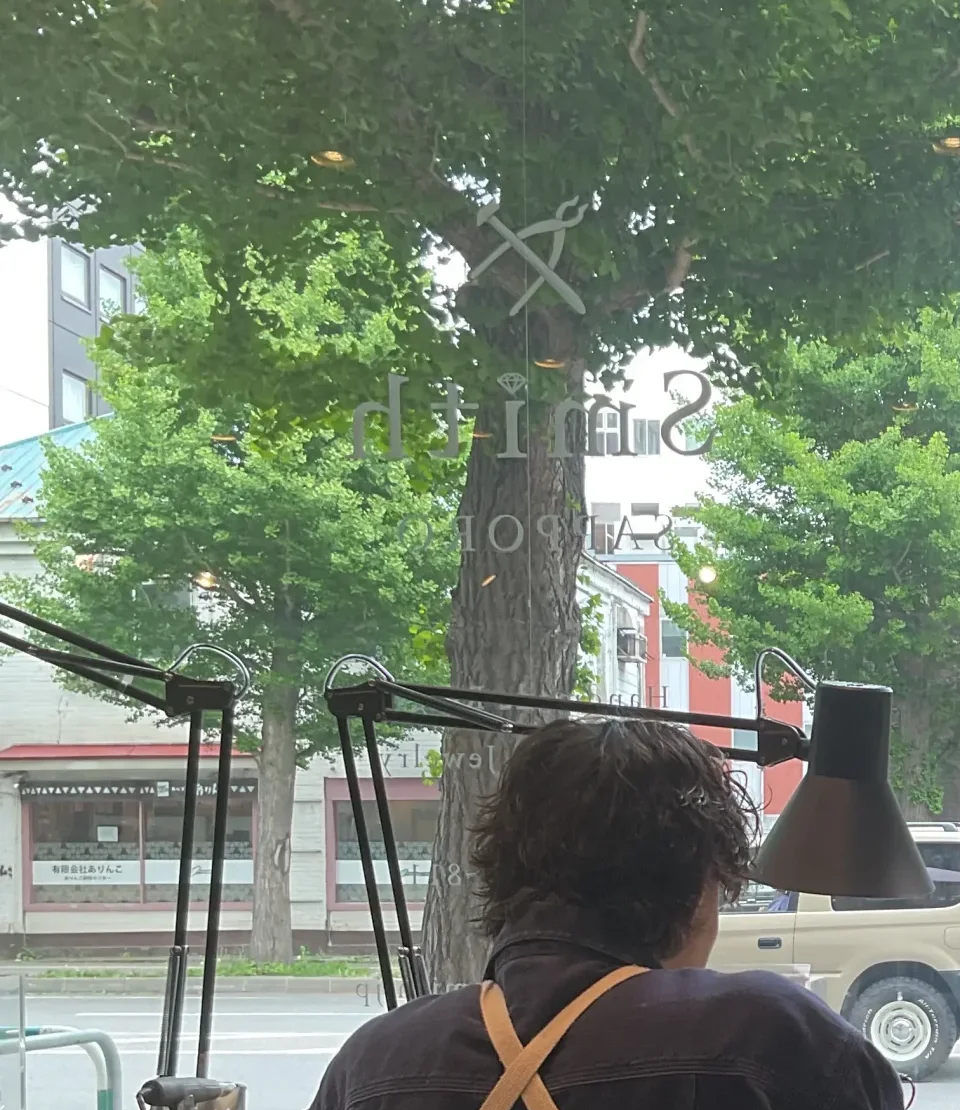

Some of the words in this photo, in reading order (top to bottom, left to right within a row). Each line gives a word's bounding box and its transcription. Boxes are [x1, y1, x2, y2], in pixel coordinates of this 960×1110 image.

[52, 864, 123, 874] 有限会社ありんこ
